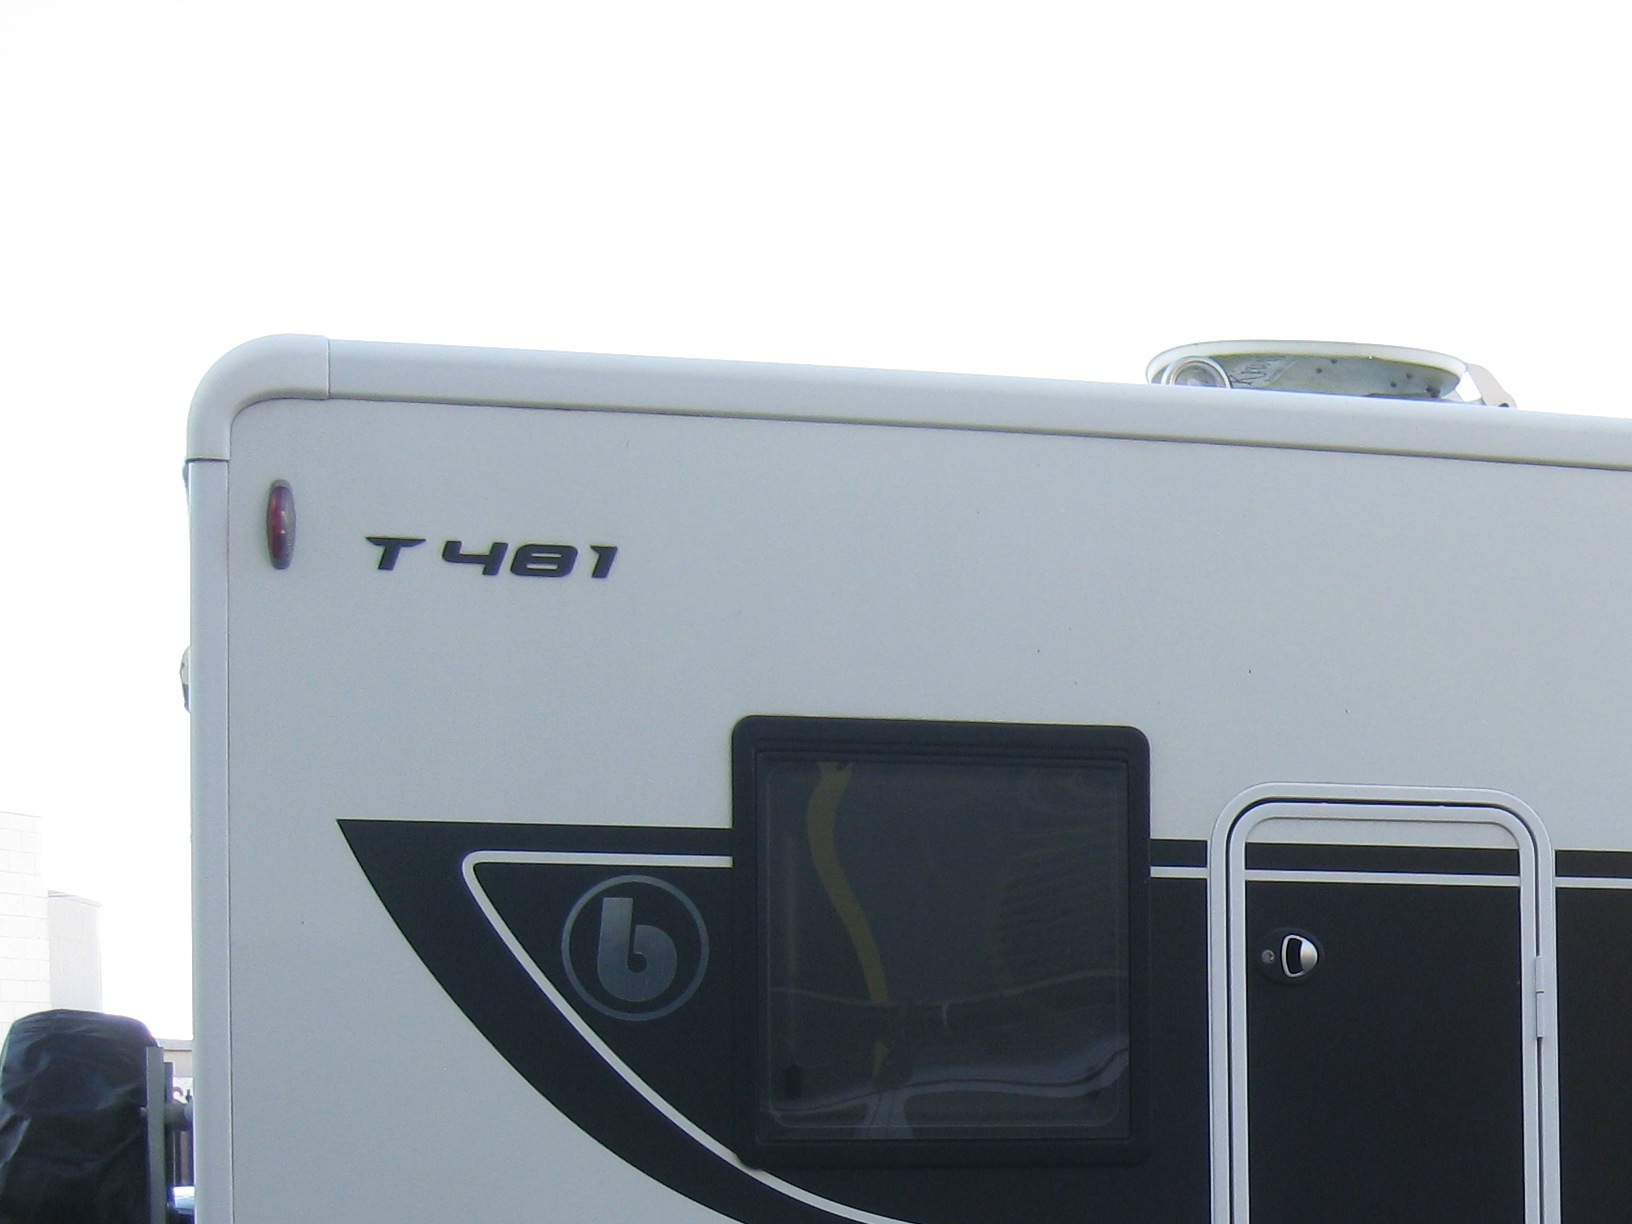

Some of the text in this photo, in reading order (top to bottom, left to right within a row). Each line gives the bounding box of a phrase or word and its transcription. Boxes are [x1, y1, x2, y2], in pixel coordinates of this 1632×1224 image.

[365, 536, 618, 578] T 481
[597, 897, 678, 1002] b
